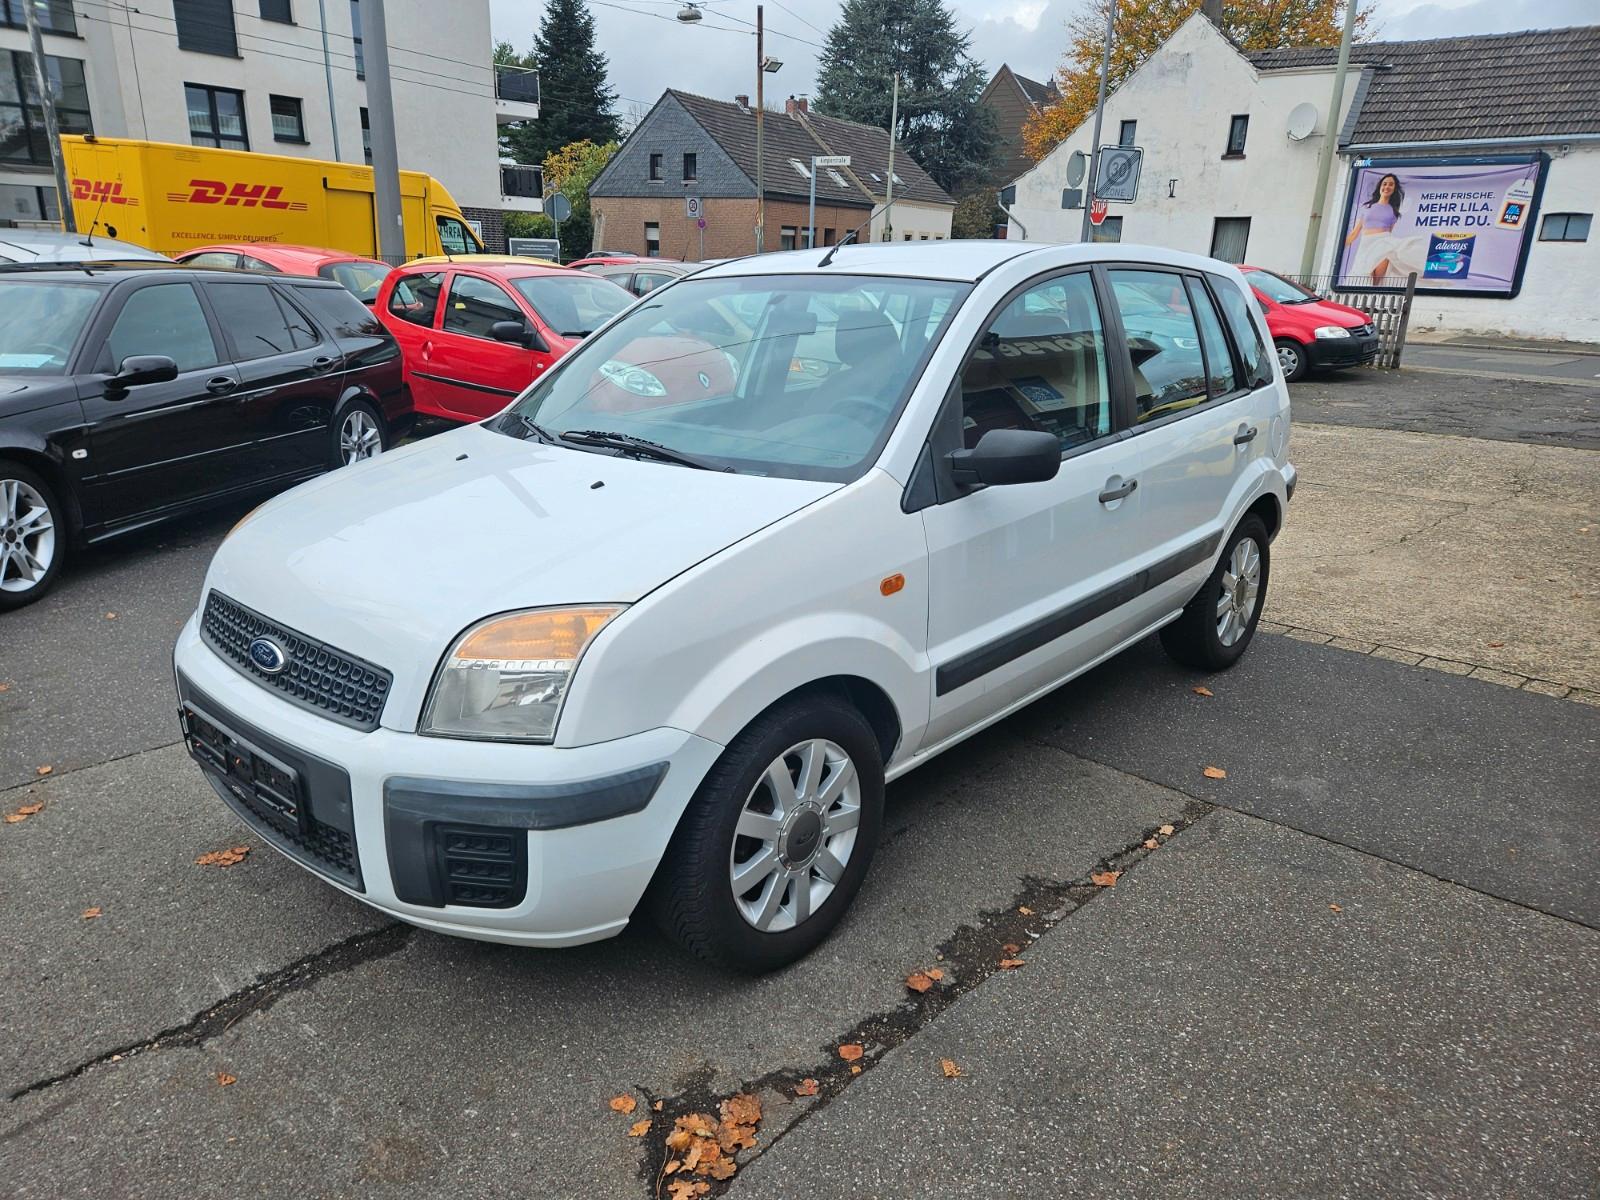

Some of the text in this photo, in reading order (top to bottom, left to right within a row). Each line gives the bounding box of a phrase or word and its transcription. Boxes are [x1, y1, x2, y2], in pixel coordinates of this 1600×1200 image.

[72, 179, 127, 204] DHL
[189, 179, 289, 209] DHL
[1421, 191, 1496, 200] MEHR FRISCHE.
[1091, 201, 1107, 213] STOP
[1418, 202, 1493, 212] MEHR LILA.
[1415, 215, 1491, 226] MEHR DU.
[172, 232, 216, 240] EXCELLENCE.
[1435, 241, 1468, 253] always
